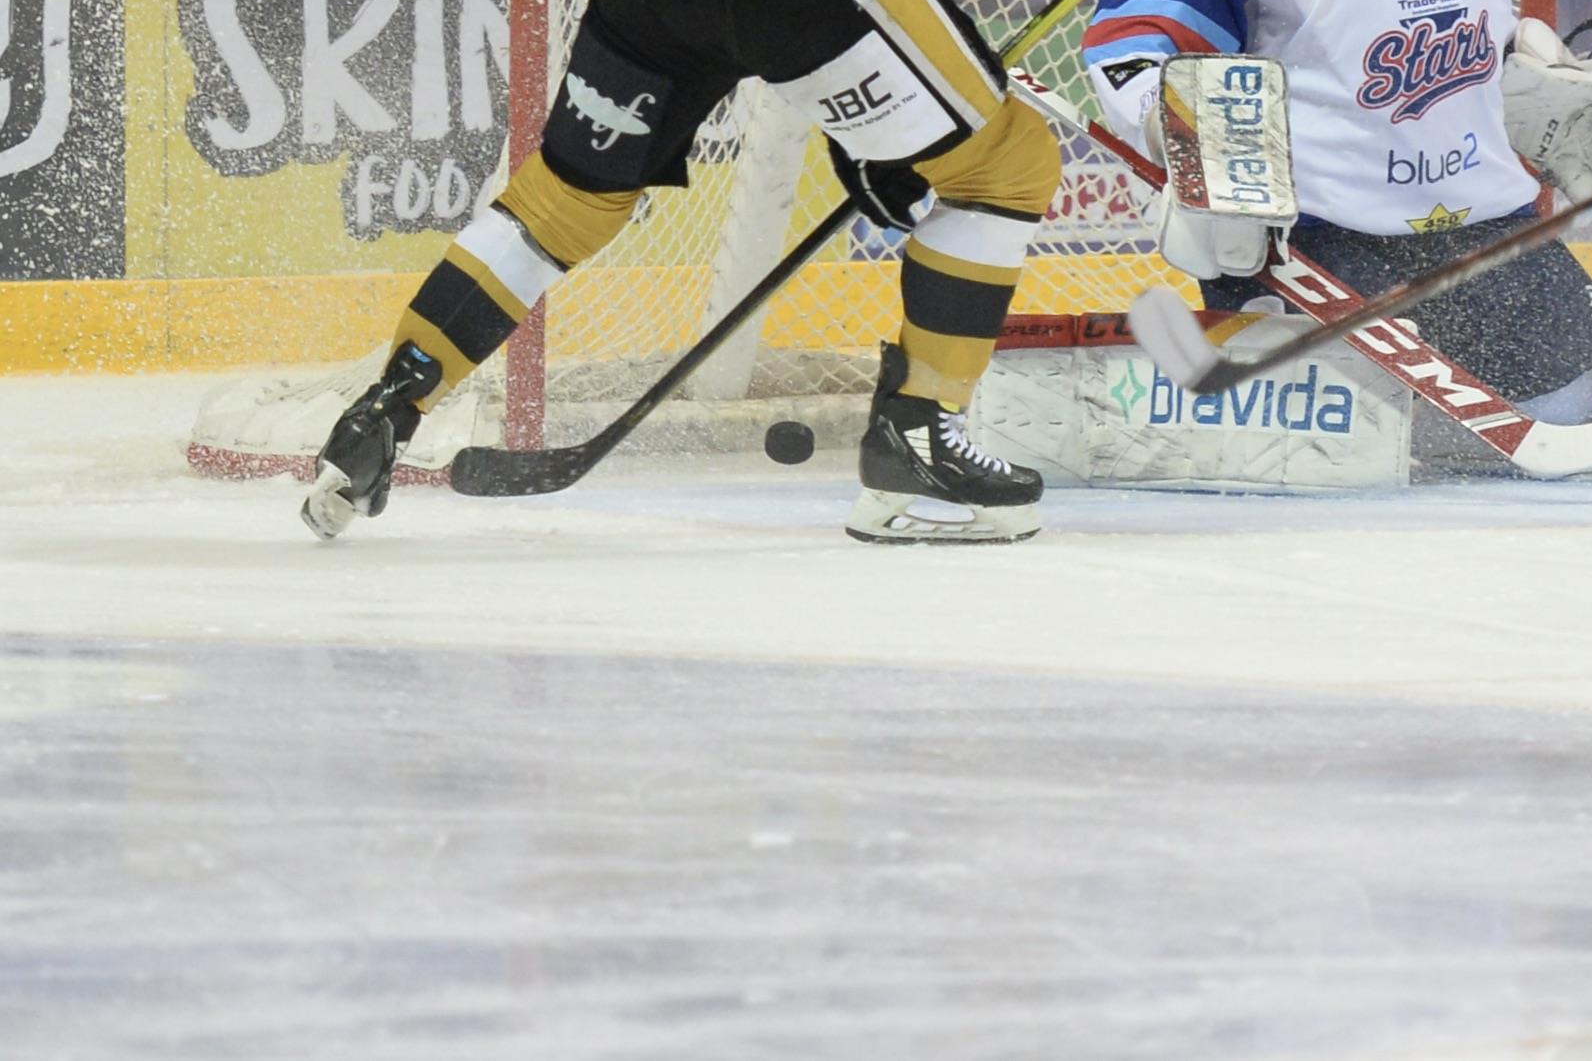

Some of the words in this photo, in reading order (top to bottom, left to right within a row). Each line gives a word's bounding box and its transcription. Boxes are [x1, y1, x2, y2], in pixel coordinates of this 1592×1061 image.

[818, 70, 893, 123] JBC
[1357, 9, 1499, 111] Stars
[1207, 65, 1271, 204] bravida
